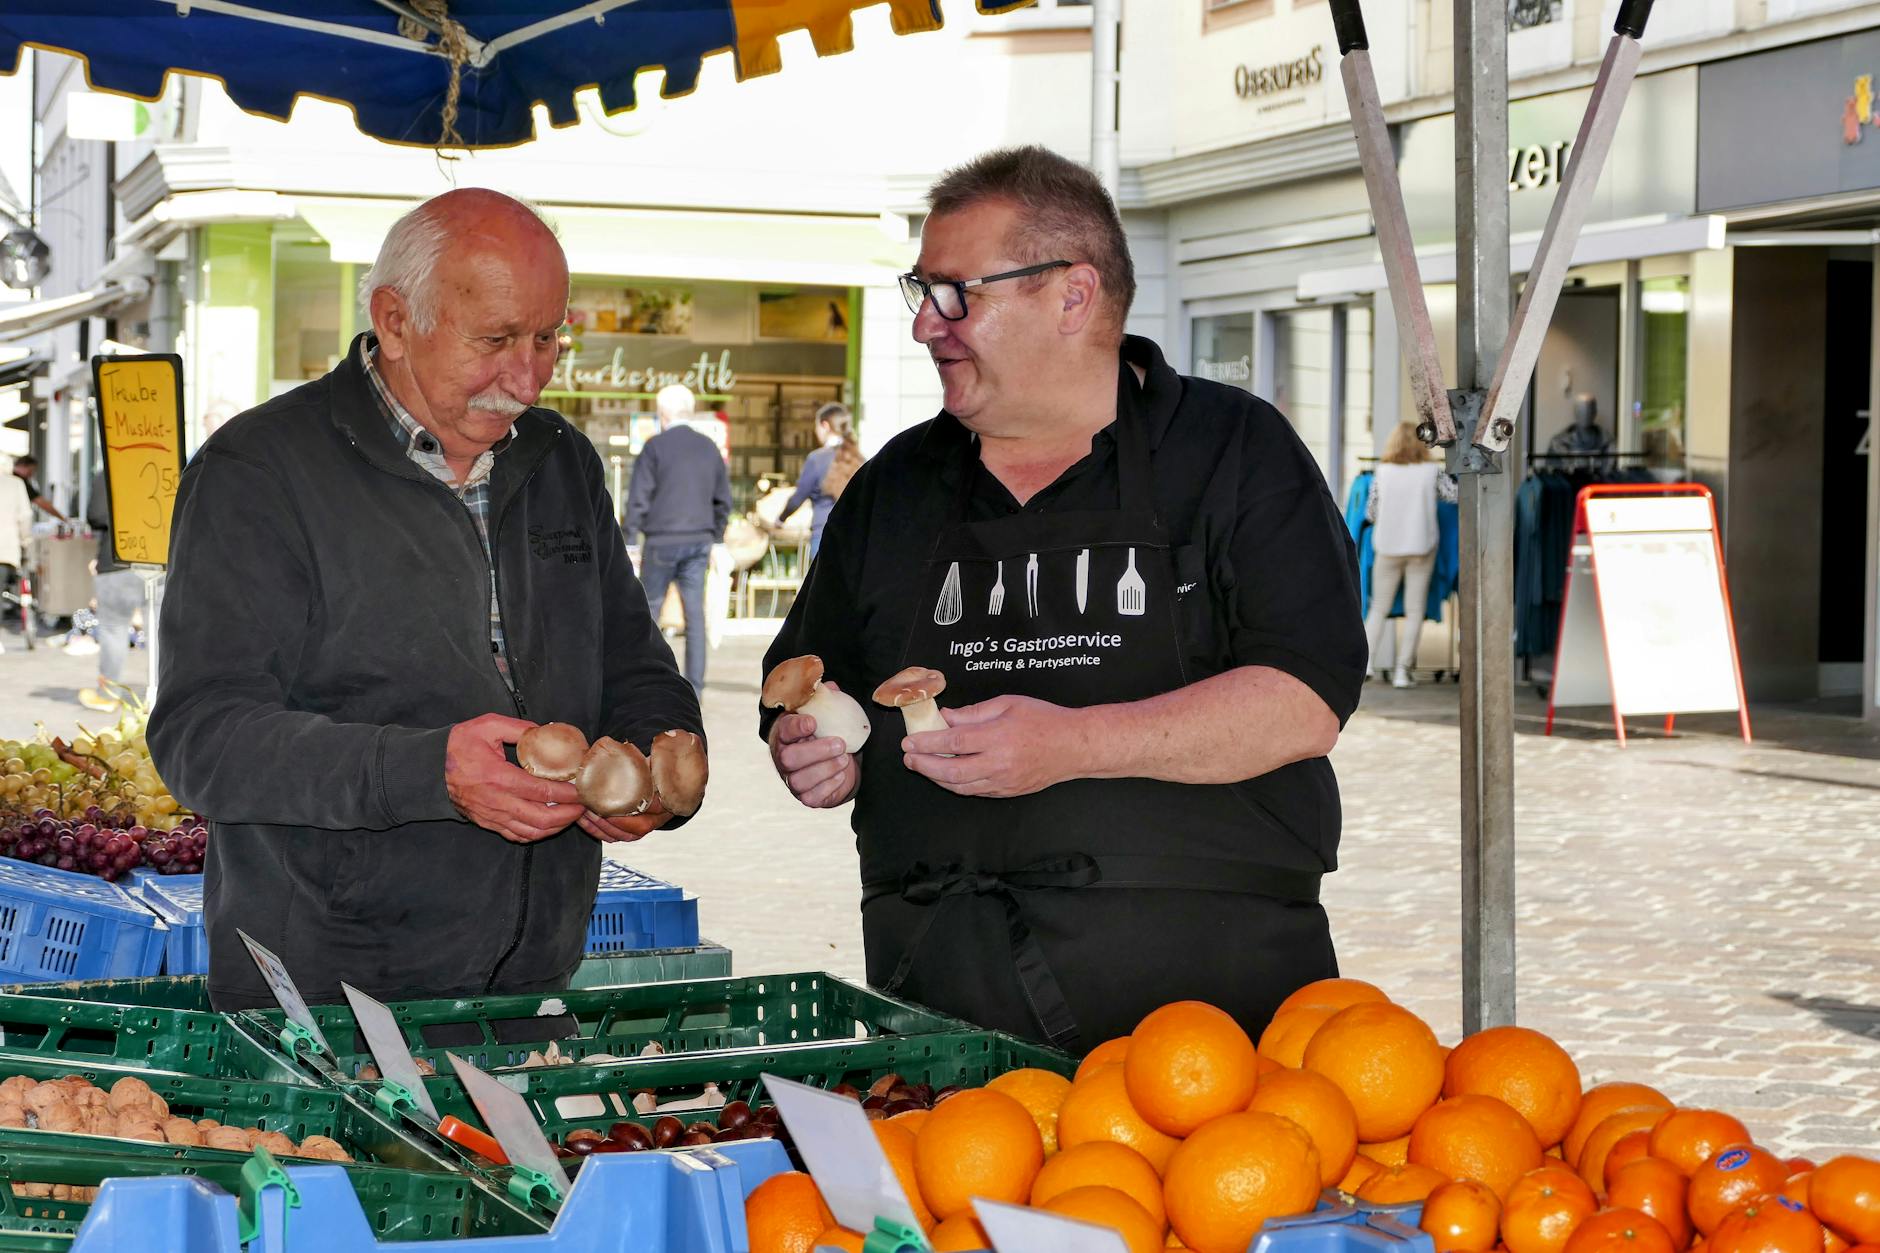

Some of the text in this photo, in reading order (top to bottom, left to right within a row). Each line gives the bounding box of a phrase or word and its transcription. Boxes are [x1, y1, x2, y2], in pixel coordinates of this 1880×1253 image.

[103, 369, 158, 404] Traube
[1004, 631, 1122, 653] Gastroservice
[965, 654, 1101, 671] Catering & Partyservice
